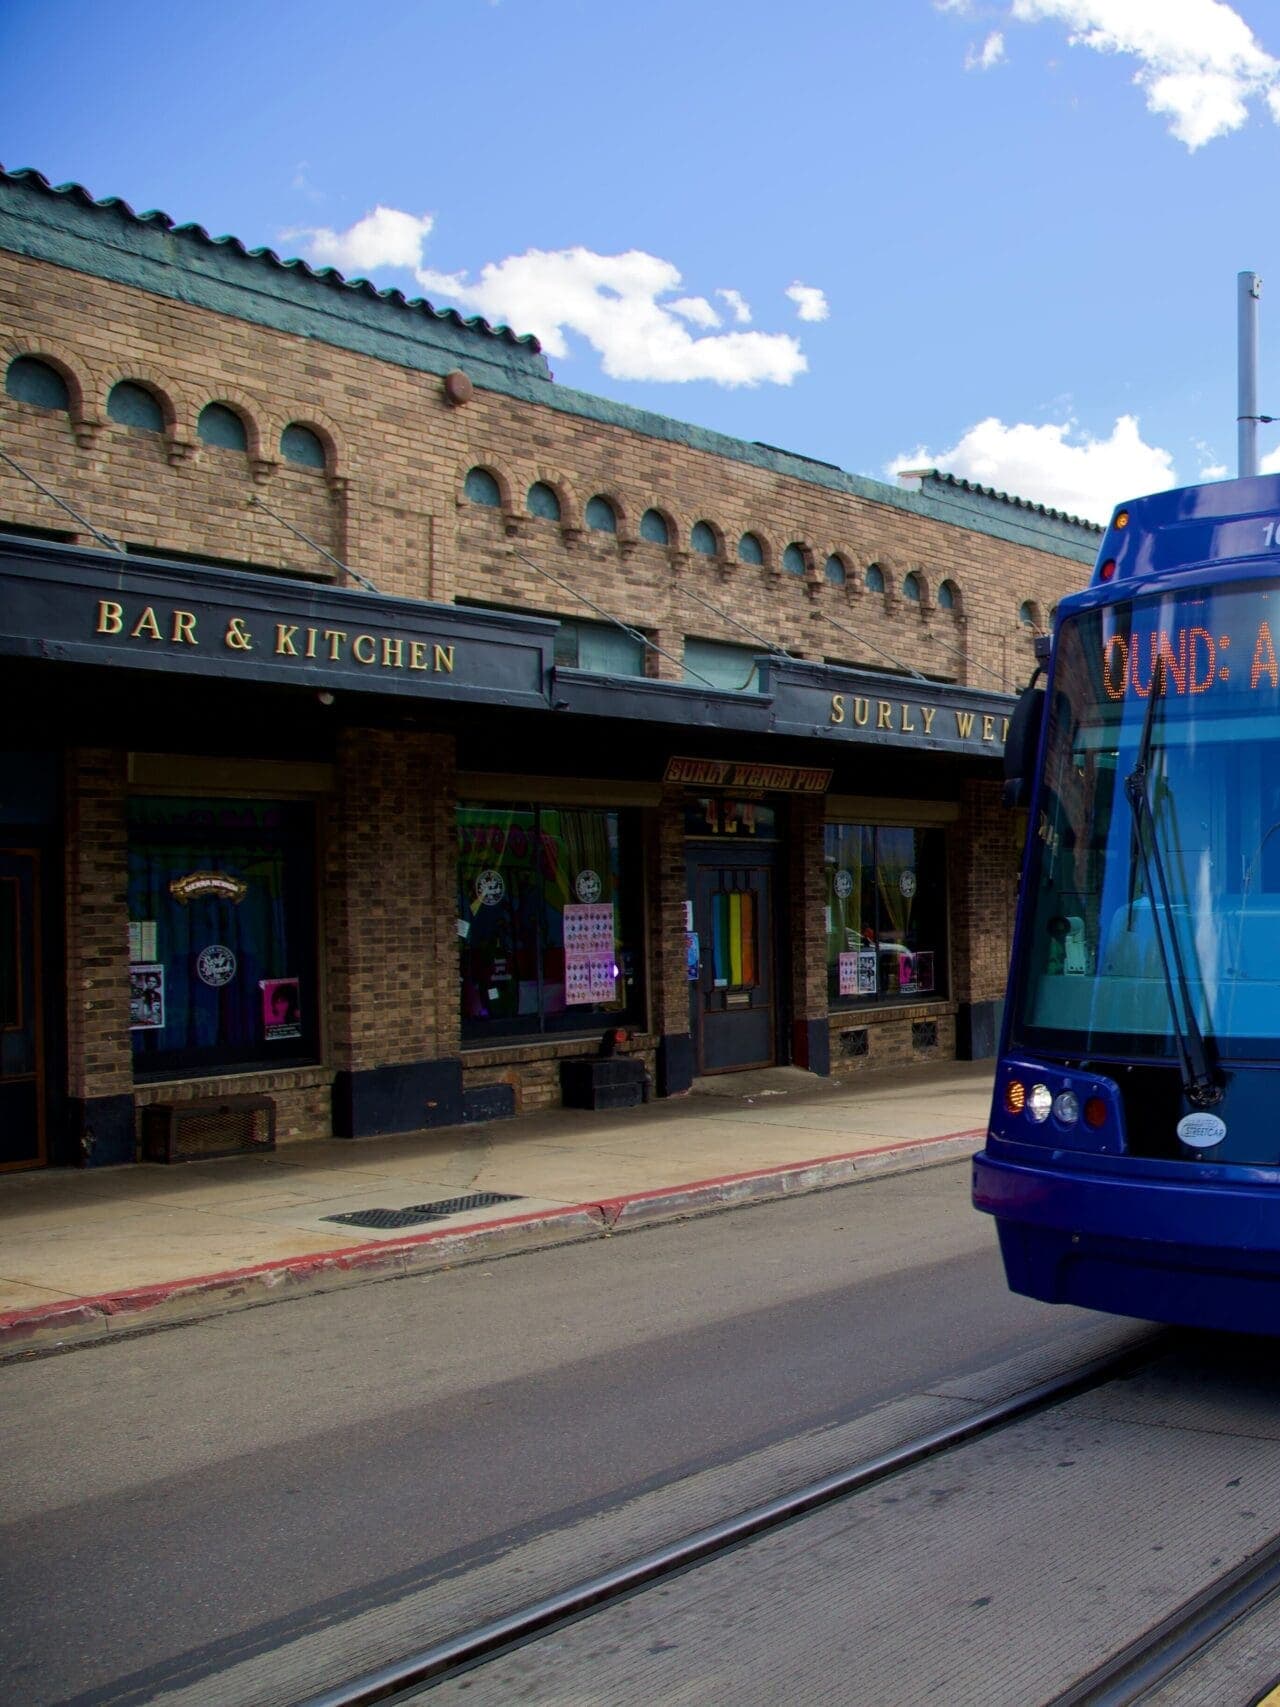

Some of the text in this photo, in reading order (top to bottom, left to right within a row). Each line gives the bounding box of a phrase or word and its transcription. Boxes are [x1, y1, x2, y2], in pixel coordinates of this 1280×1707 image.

[97, 600, 455, 673] BAR & KITCHEN
[1103, 626, 1231, 699] OUND:
[831, 694, 936, 734] SURLY
[668, 759, 830, 791] SURLY WENCH PUB
